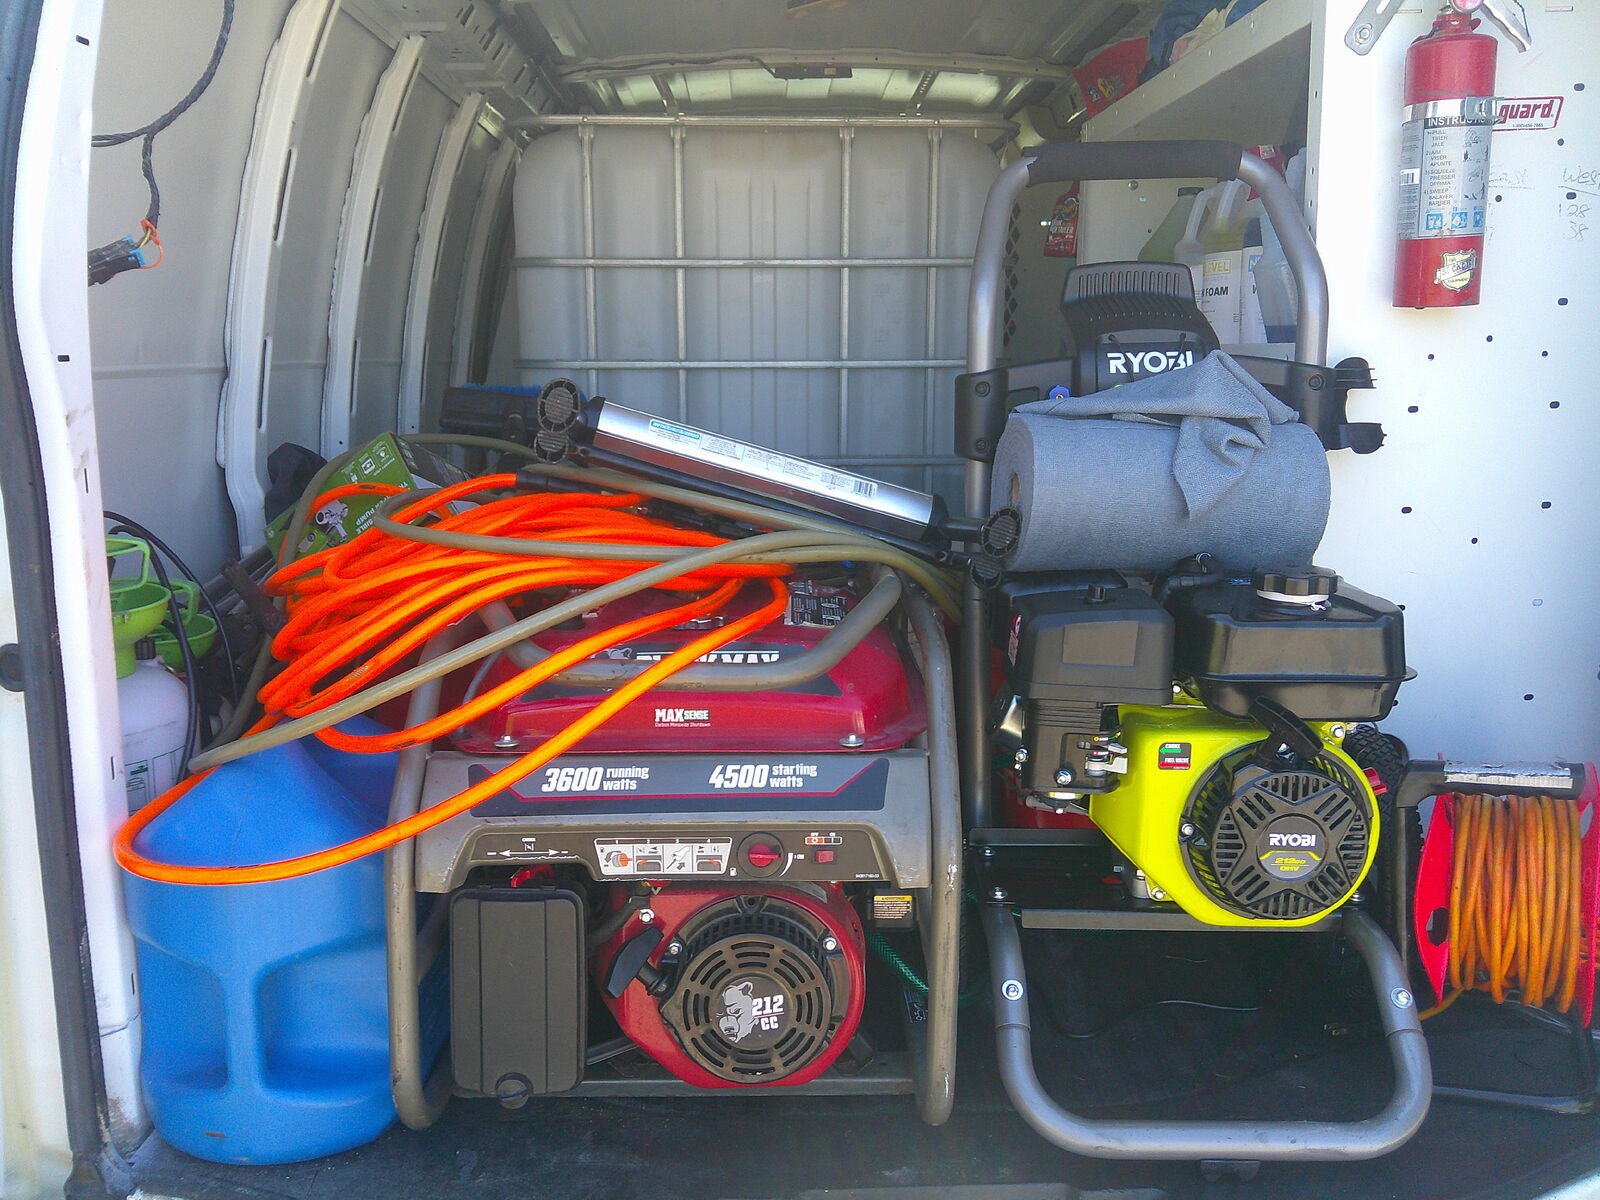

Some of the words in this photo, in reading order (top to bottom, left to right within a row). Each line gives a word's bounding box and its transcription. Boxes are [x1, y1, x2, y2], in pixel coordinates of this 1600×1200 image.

[1107, 350, 1194, 374] RYOBI
[541, 767, 604, 792] 3600
[606, 765, 649, 780] running
[602, 779, 637, 791] watts
[708, 764, 770, 788] 4500
[772, 763, 818, 777] starting
[769, 776, 804, 788] watts
[1269, 833, 1317, 847] RYOBI
[752, 994, 784, 1016] 212
